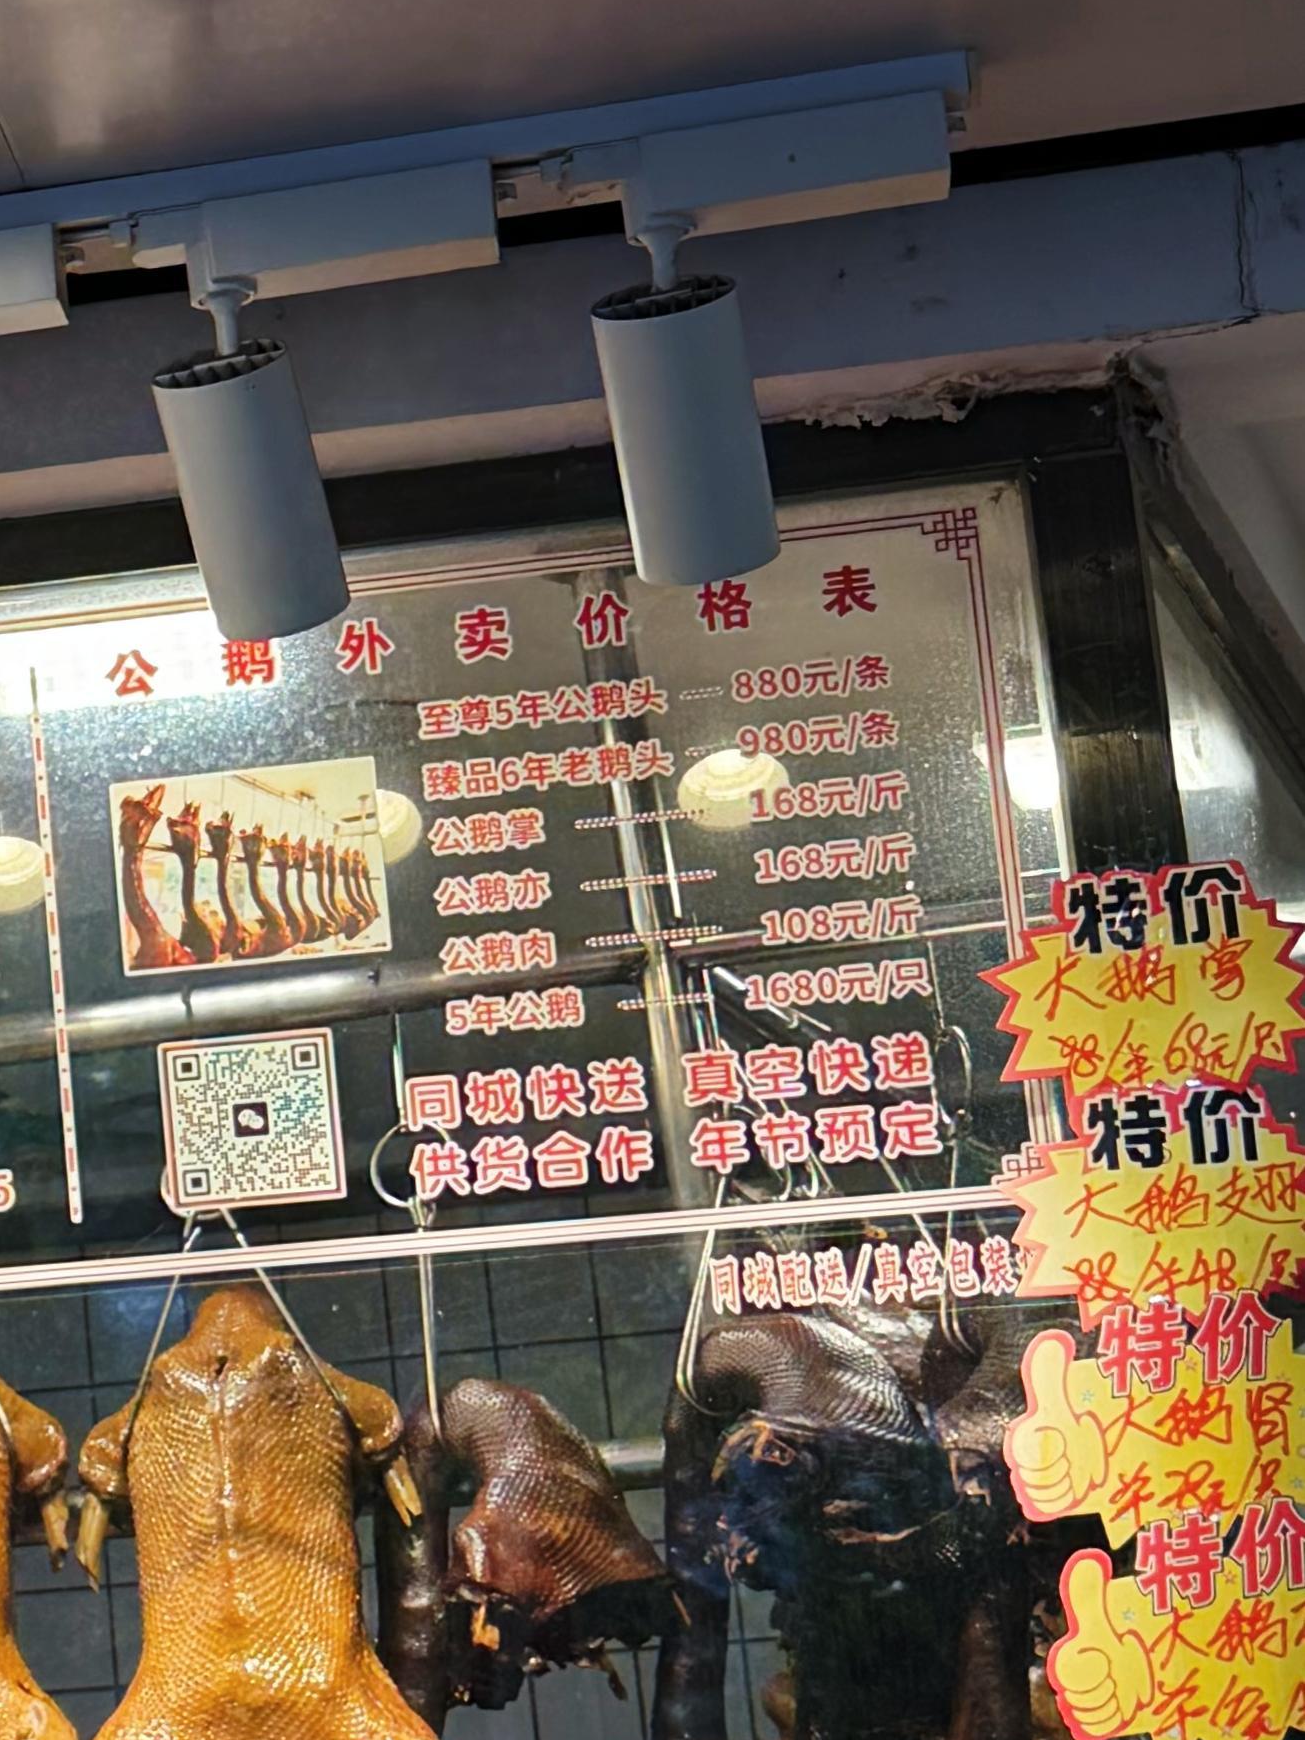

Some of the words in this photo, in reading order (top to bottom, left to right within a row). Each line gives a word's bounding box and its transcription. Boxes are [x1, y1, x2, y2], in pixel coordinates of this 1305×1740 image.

[104, 564, 878, 697] 公鹅外卖价格表
[419, 677, 668, 740] 至尊5年公鹅头
[732, 655, 890, 703] 880元/条
[423, 740, 674, 800] 臻品6年老鹅头
[738, 711, 896, 757] 980元/条
[429, 809, 545, 855] 公鹅掌
[750, 770, 909, 821] 168元/斤
[434, 869, 551, 915] 公鹅亦
[754, 834, 915, 883] 168元/斤
[1069, 865, 1245, 952] 特价
[440, 929, 556, 974] 公鹅肉
[762, 896, 922, 945] 108元/斤
[446, 987, 585, 1035] 5年公鹅
[745, 958, 933, 1011] 1680元/只
[405, 1057, 647, 1130] 同城快送
[683, 1033, 933, 1106] 真空快递
[410, 1125, 654, 1199] 供货合作
[690, 1101, 942, 1172] 年节预定
[1084, 1088, 1264, 1170] 特价
[709, 1235, 1035, 1314] 同城配送/真空包装
[1097, 1290, 1280, 1396] 特价
[1136, 1497, 1305, 1613] 特价
[1150, 1599, 1305, 1670] 大鹅
